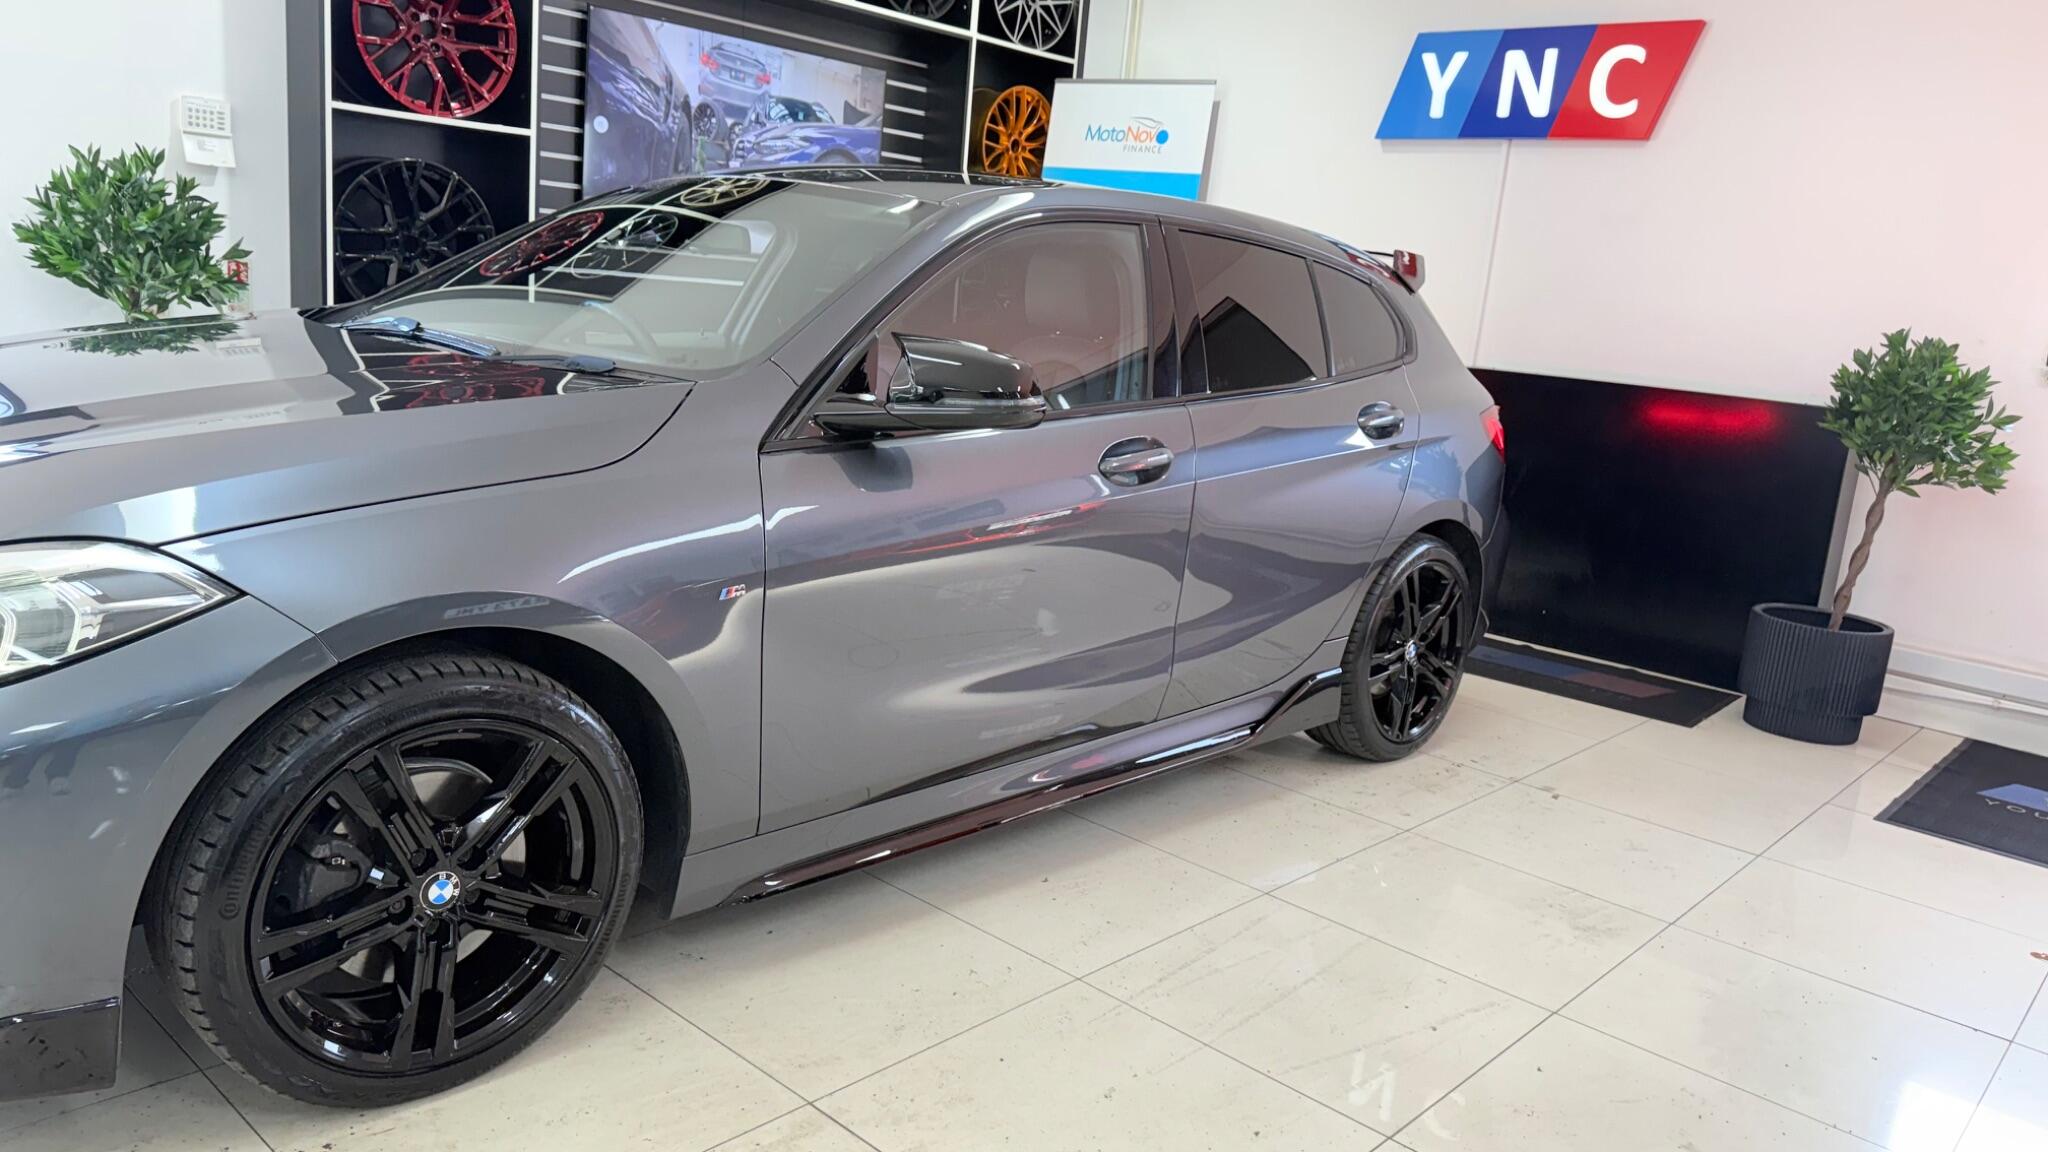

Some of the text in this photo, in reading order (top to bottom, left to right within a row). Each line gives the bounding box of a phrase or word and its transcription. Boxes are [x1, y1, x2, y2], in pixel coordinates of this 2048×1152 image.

[1421, 44, 1646, 119] YNC
[1085, 124, 1168, 144] MotoNovo
[1123, 144, 1162, 154] FINANCE
